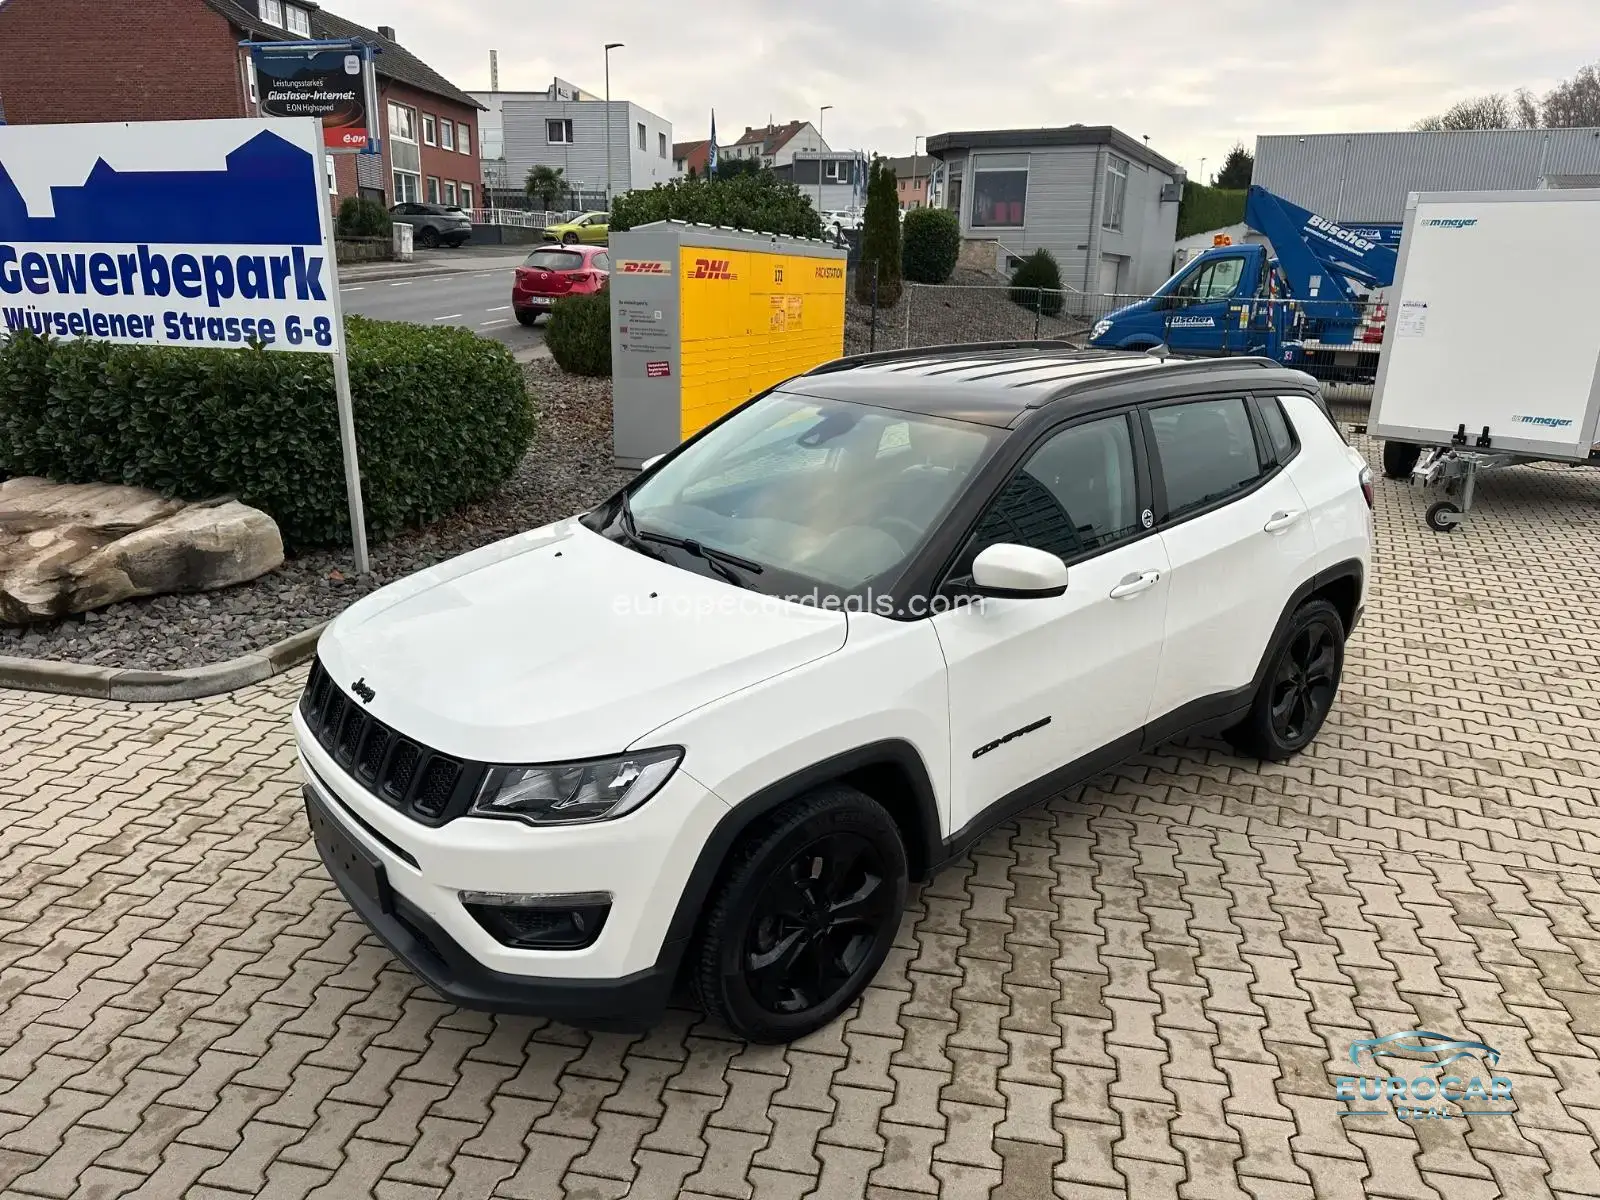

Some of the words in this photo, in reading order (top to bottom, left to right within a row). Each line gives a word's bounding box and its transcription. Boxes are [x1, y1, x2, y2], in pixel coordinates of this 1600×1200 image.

[272, 79, 324, 88] Leistungsstarkes
[268, 90, 356, 101] Glasfaser-Internet:
[286, 103, 302, 112] E.ON
[303, 103, 334, 113] Highspeed
[1307, 214, 1376, 251] Büscher
[0, 245, 327, 307] Gewerbepark
[624, 262, 664, 273] DHL
[694, 258, 732, 280] DHL
[815, 267, 843, 279] PACKSTATION
[2, 305, 155, 338] Würselener
[163, 311, 276, 344] Strasse
[285, 315, 333, 346] 6-8
[351, 677, 376, 705] Jeep
